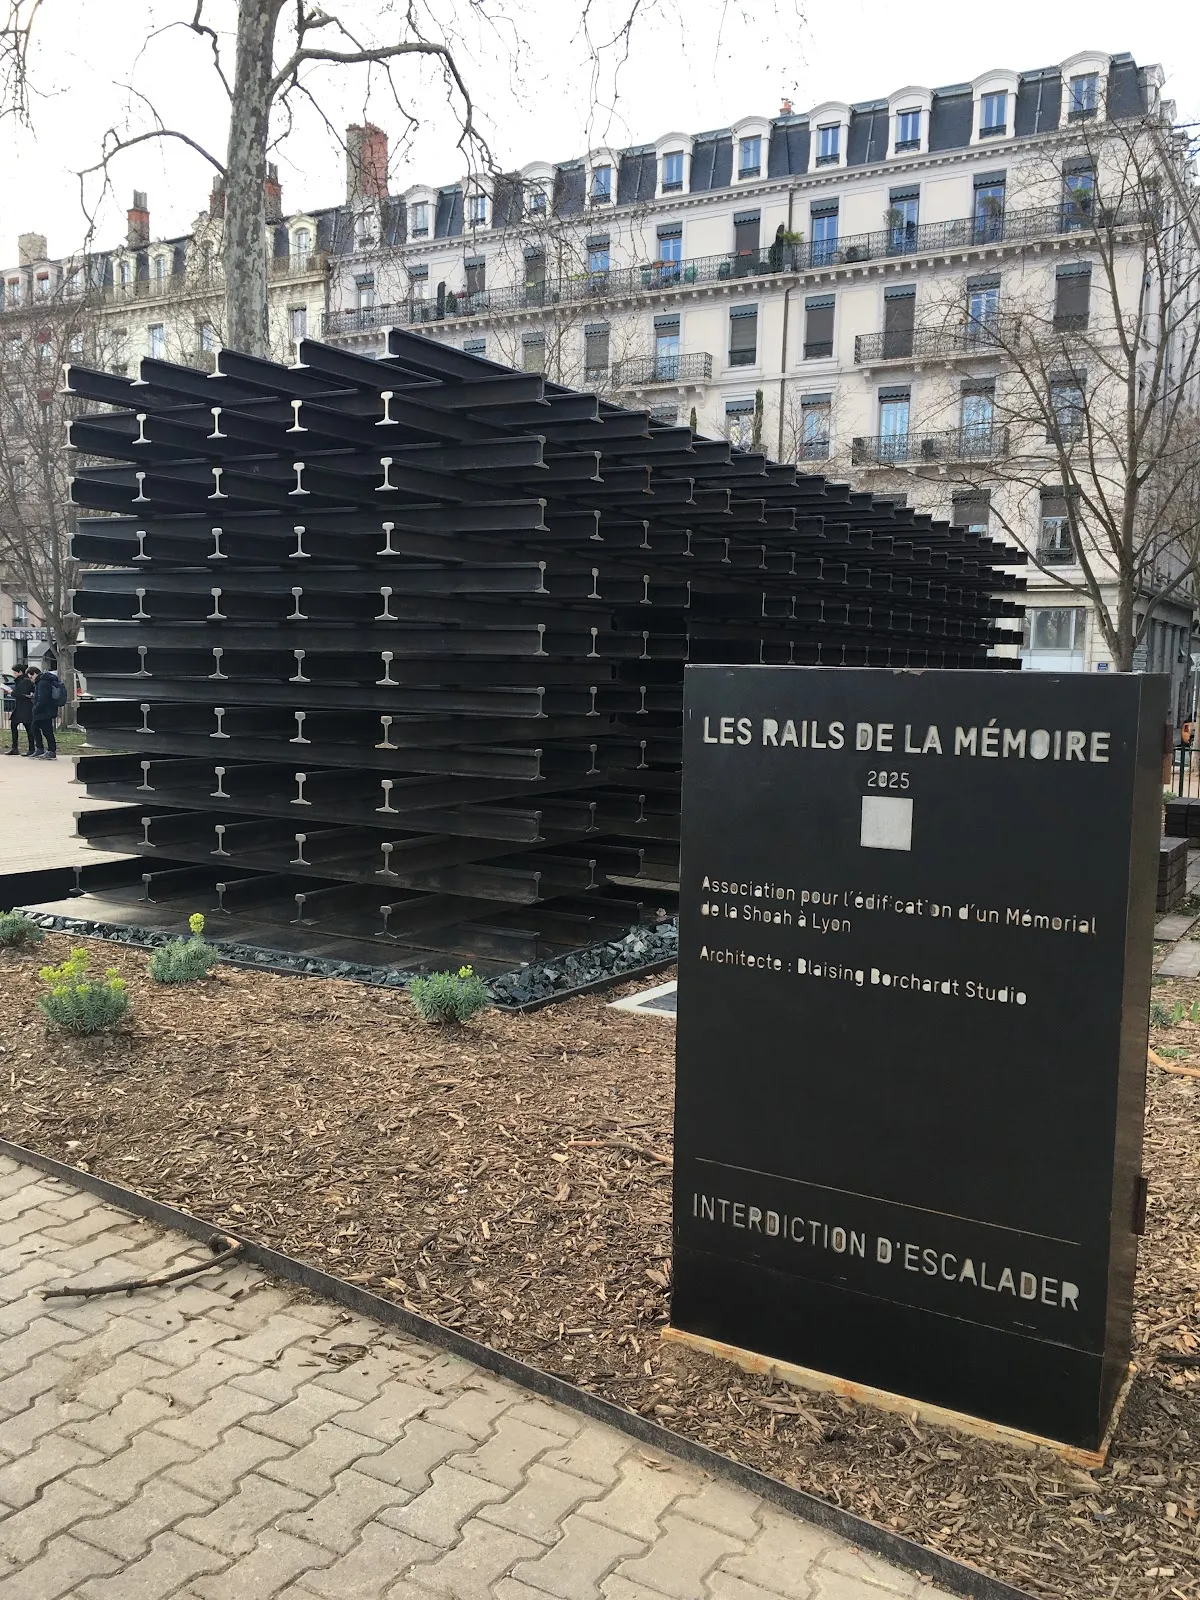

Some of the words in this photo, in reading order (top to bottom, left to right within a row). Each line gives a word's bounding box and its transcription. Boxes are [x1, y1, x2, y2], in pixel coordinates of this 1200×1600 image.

[703, 717, 752, 745] LES
[763, 719, 844, 749] RAILS
[856, 723, 893, 752] DE
[905, 724, 942, 754] LA
[955, 718, 1110, 762] MÉMOIRE
[868, 771, 909, 789] 2025
[701, 901, 719, 916] de
[725, 903, 737, 918] la
[743, 905, 791, 924] Shoah
[798, 910, 806, 927] à
[813, 913, 850, 934] Lyon
[702, 876, 795, 900] Association
[801, 891, 838, 906] pour
[844, 891, 951, 917] l'édifcaton
[959, 904, 999, 923] d'un
[1007, 908, 1095, 933] Mémorial
[700, 946, 781, 970] Architecte
[798, 958, 864, 986] Blaising
[871, 968, 959, 995] Borchardt
[966, 981, 1026, 1005] Studio
[694, 1193, 865, 1257] INTERDICTION
[877, 1237, 1079, 1310] D'ESCALADER
